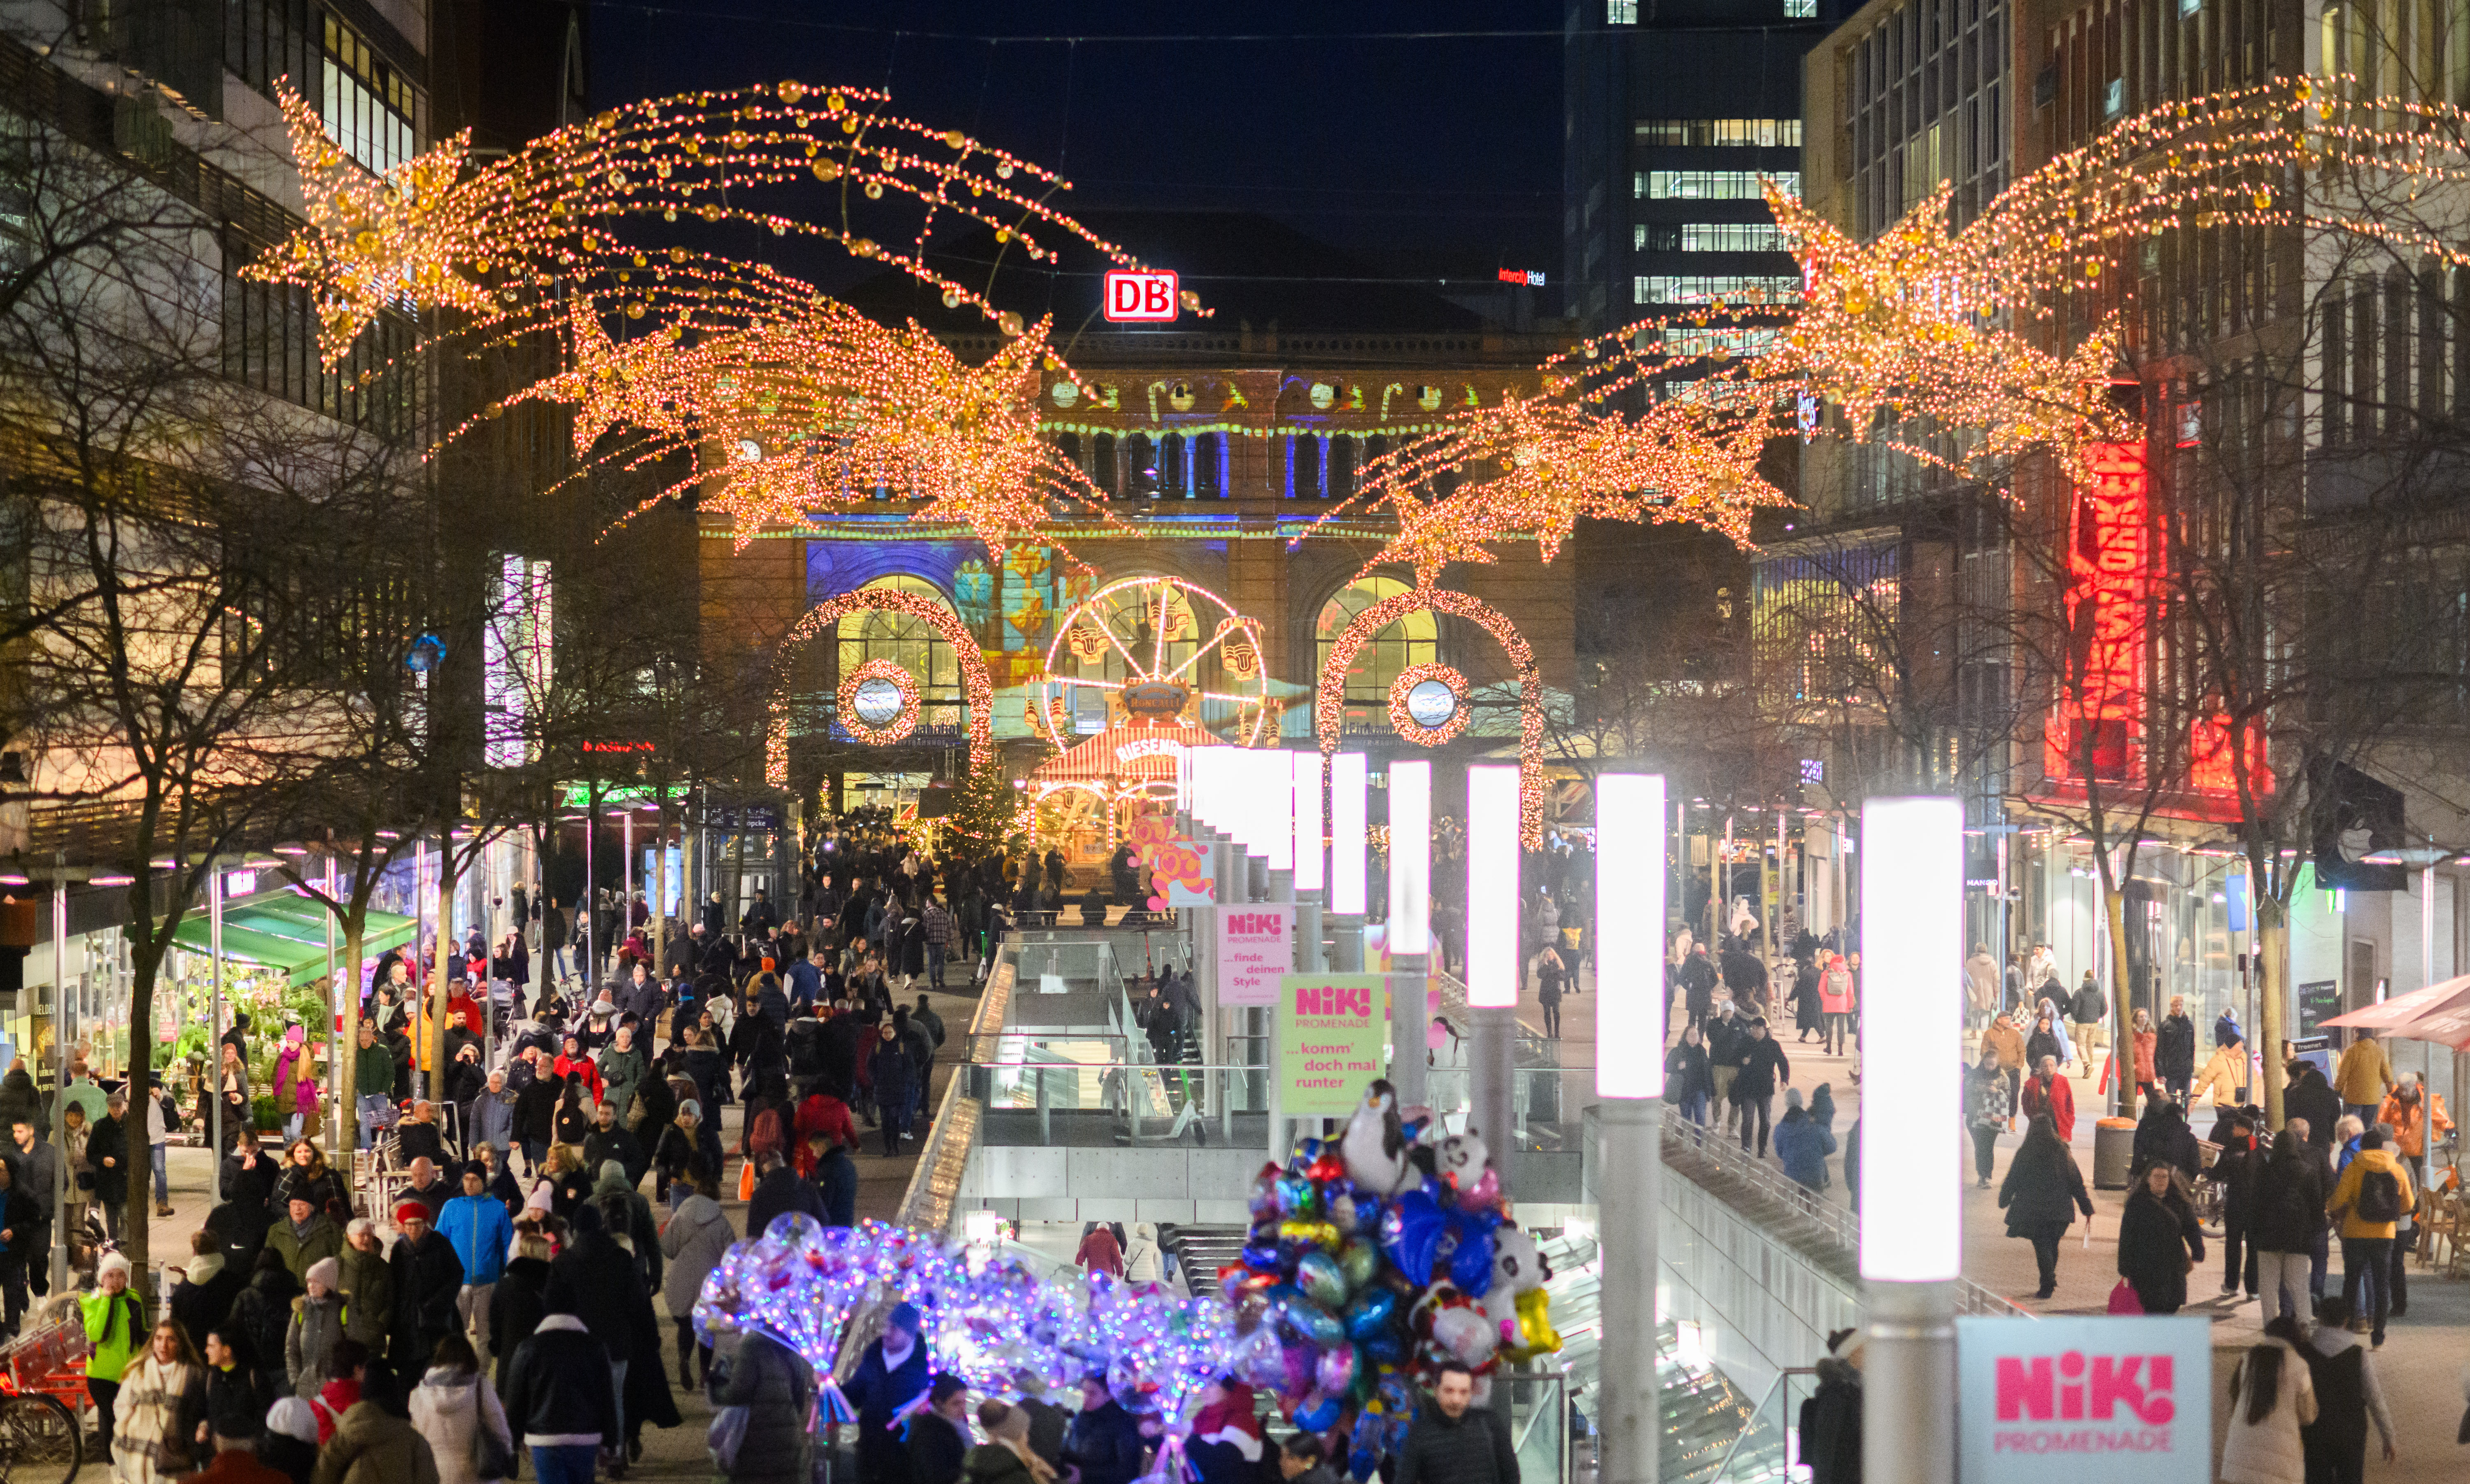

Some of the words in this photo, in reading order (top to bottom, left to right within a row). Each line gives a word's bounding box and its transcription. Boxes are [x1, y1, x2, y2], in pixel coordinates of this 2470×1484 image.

[1115, 280, 1169, 312] DB
[1116, 738, 1180, 762] RIESENR
[1247, 964, 1284, 974] deinen
[1233, 977, 1260, 988] Style
[1296, 1018, 1369, 1028] PROMENADE
[1304, 1059, 1343, 1071] doch
[1348, 1059, 1376, 1071] mal
[1296, 1077, 1345, 1088] runter
[1994, 1429, 2173, 1454] PROMENADE
